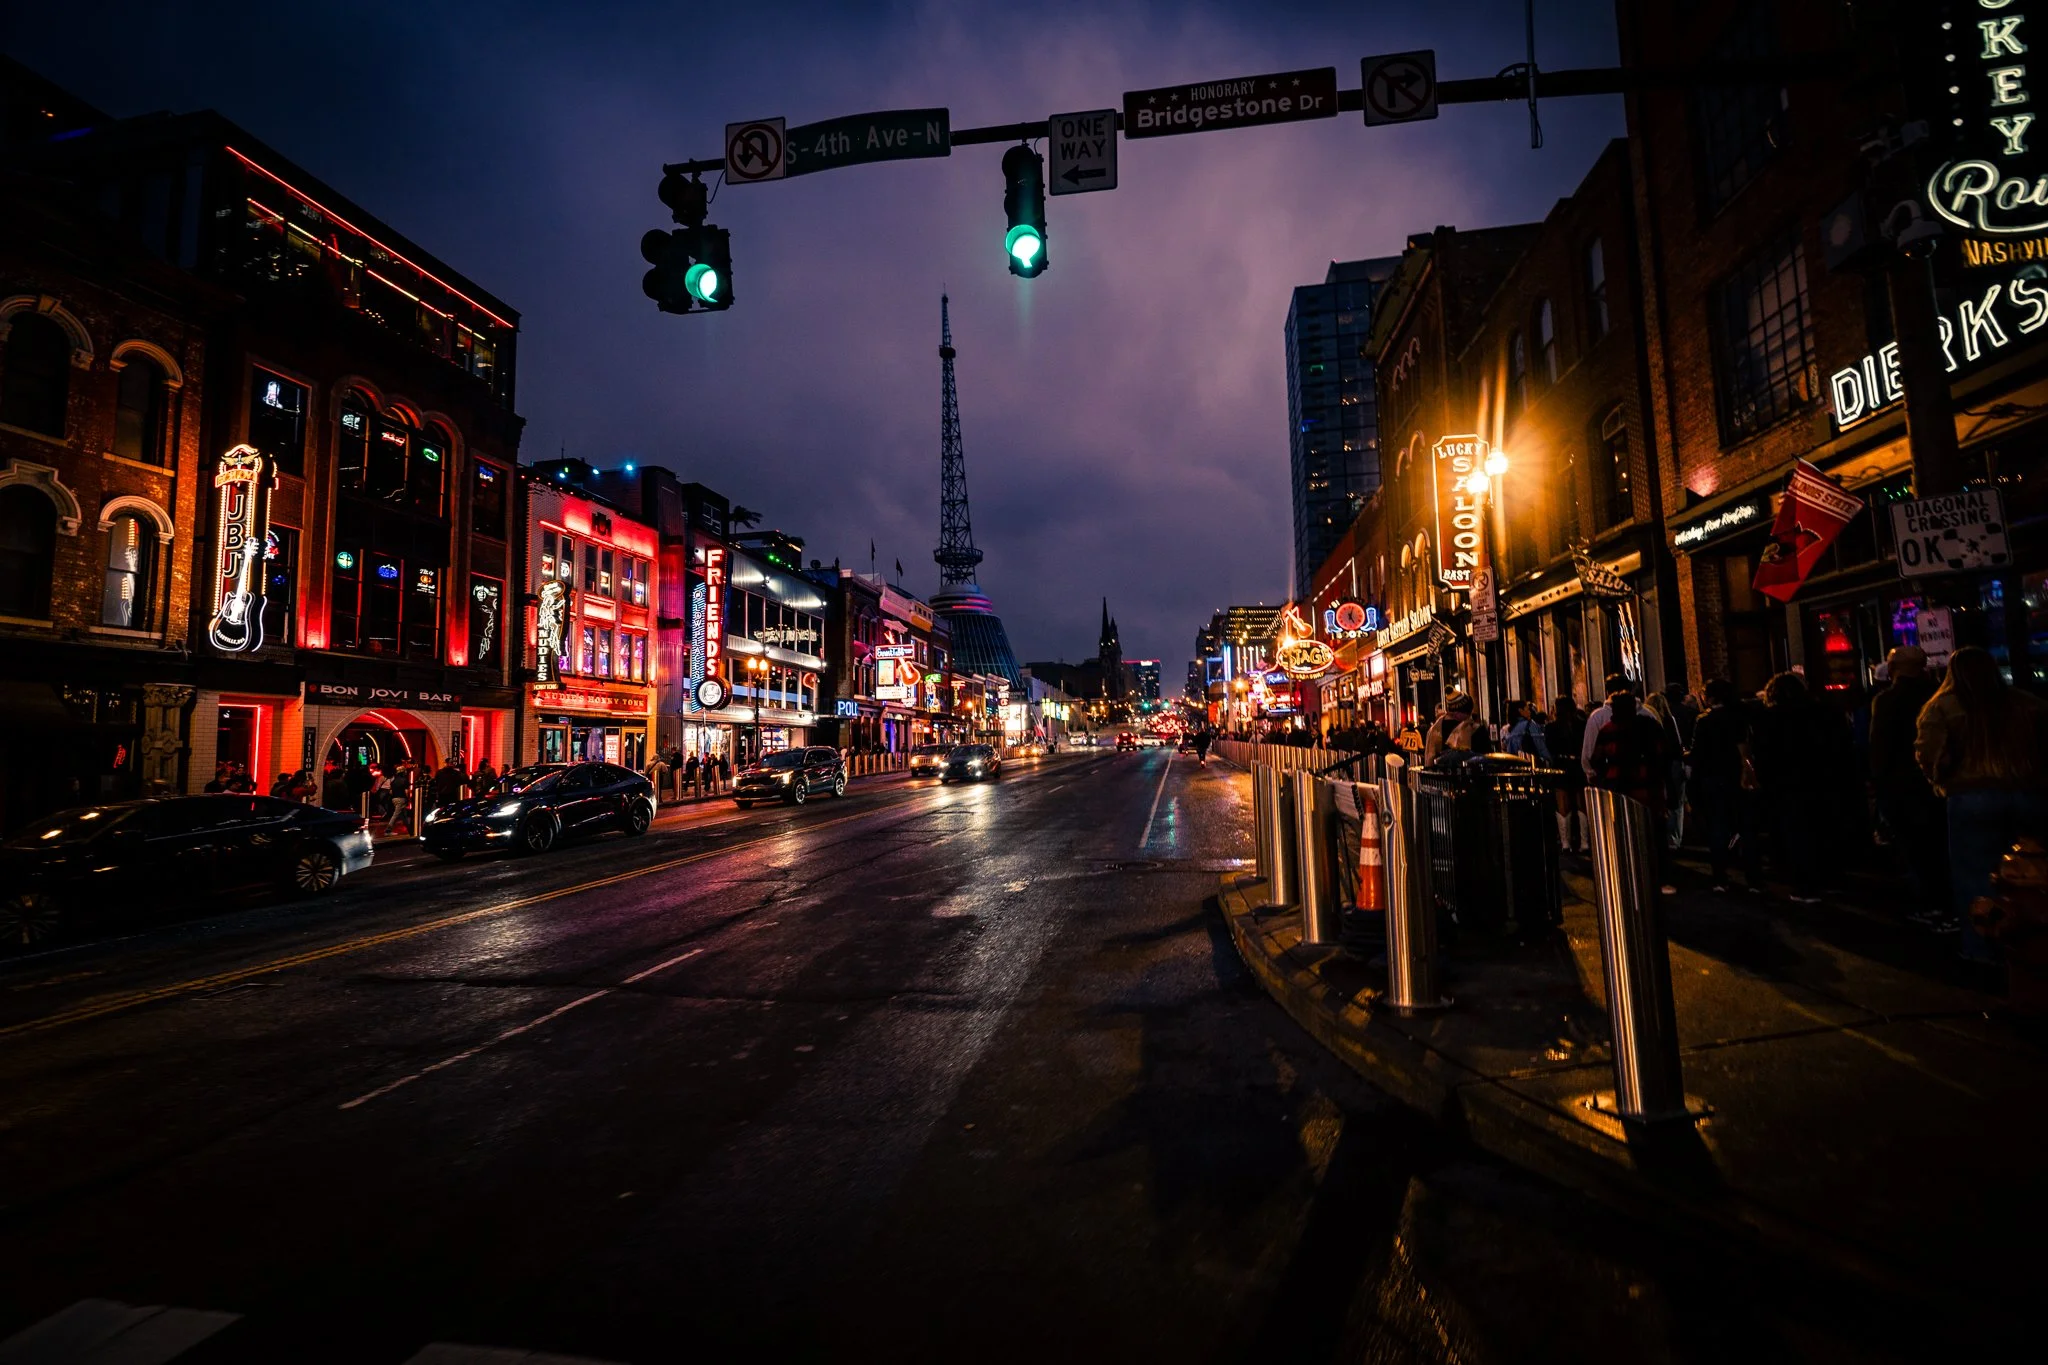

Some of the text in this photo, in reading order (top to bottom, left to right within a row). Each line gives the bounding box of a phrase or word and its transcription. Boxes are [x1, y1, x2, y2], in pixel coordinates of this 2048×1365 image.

[1190, 79, 1257, 101] HONORARY
[1977, 0, 2036, 155] KEY
[1137, 93, 1324, 129] Bridgestone Dr
[1060, 116, 1106, 139] ONE
[1060, 139, 1107, 161] WAY
[1436, 441, 1483, 459] LUCKY
[1451, 456, 1482, 568] SALOON
[1822, 493, 1856, 515] STATE
[1904, 490, 1990, 518] DIAGONAL
[1907, 507, 1992, 534] CROSSING
[224, 494, 245, 579] JBJ
[1901, 535, 1946, 567] OK
[706, 548, 724, 677] FRIENDS
[1927, 616, 1938, 628] NO
[537, 629, 550, 682] NUDIES
[1280, 646, 1331, 666] STAGE
[320, 684, 359, 696] BON
[367, 687, 409, 700] JOVI
[418, 691, 453, 703] BAR
[587, 695, 619, 705] HONKY
